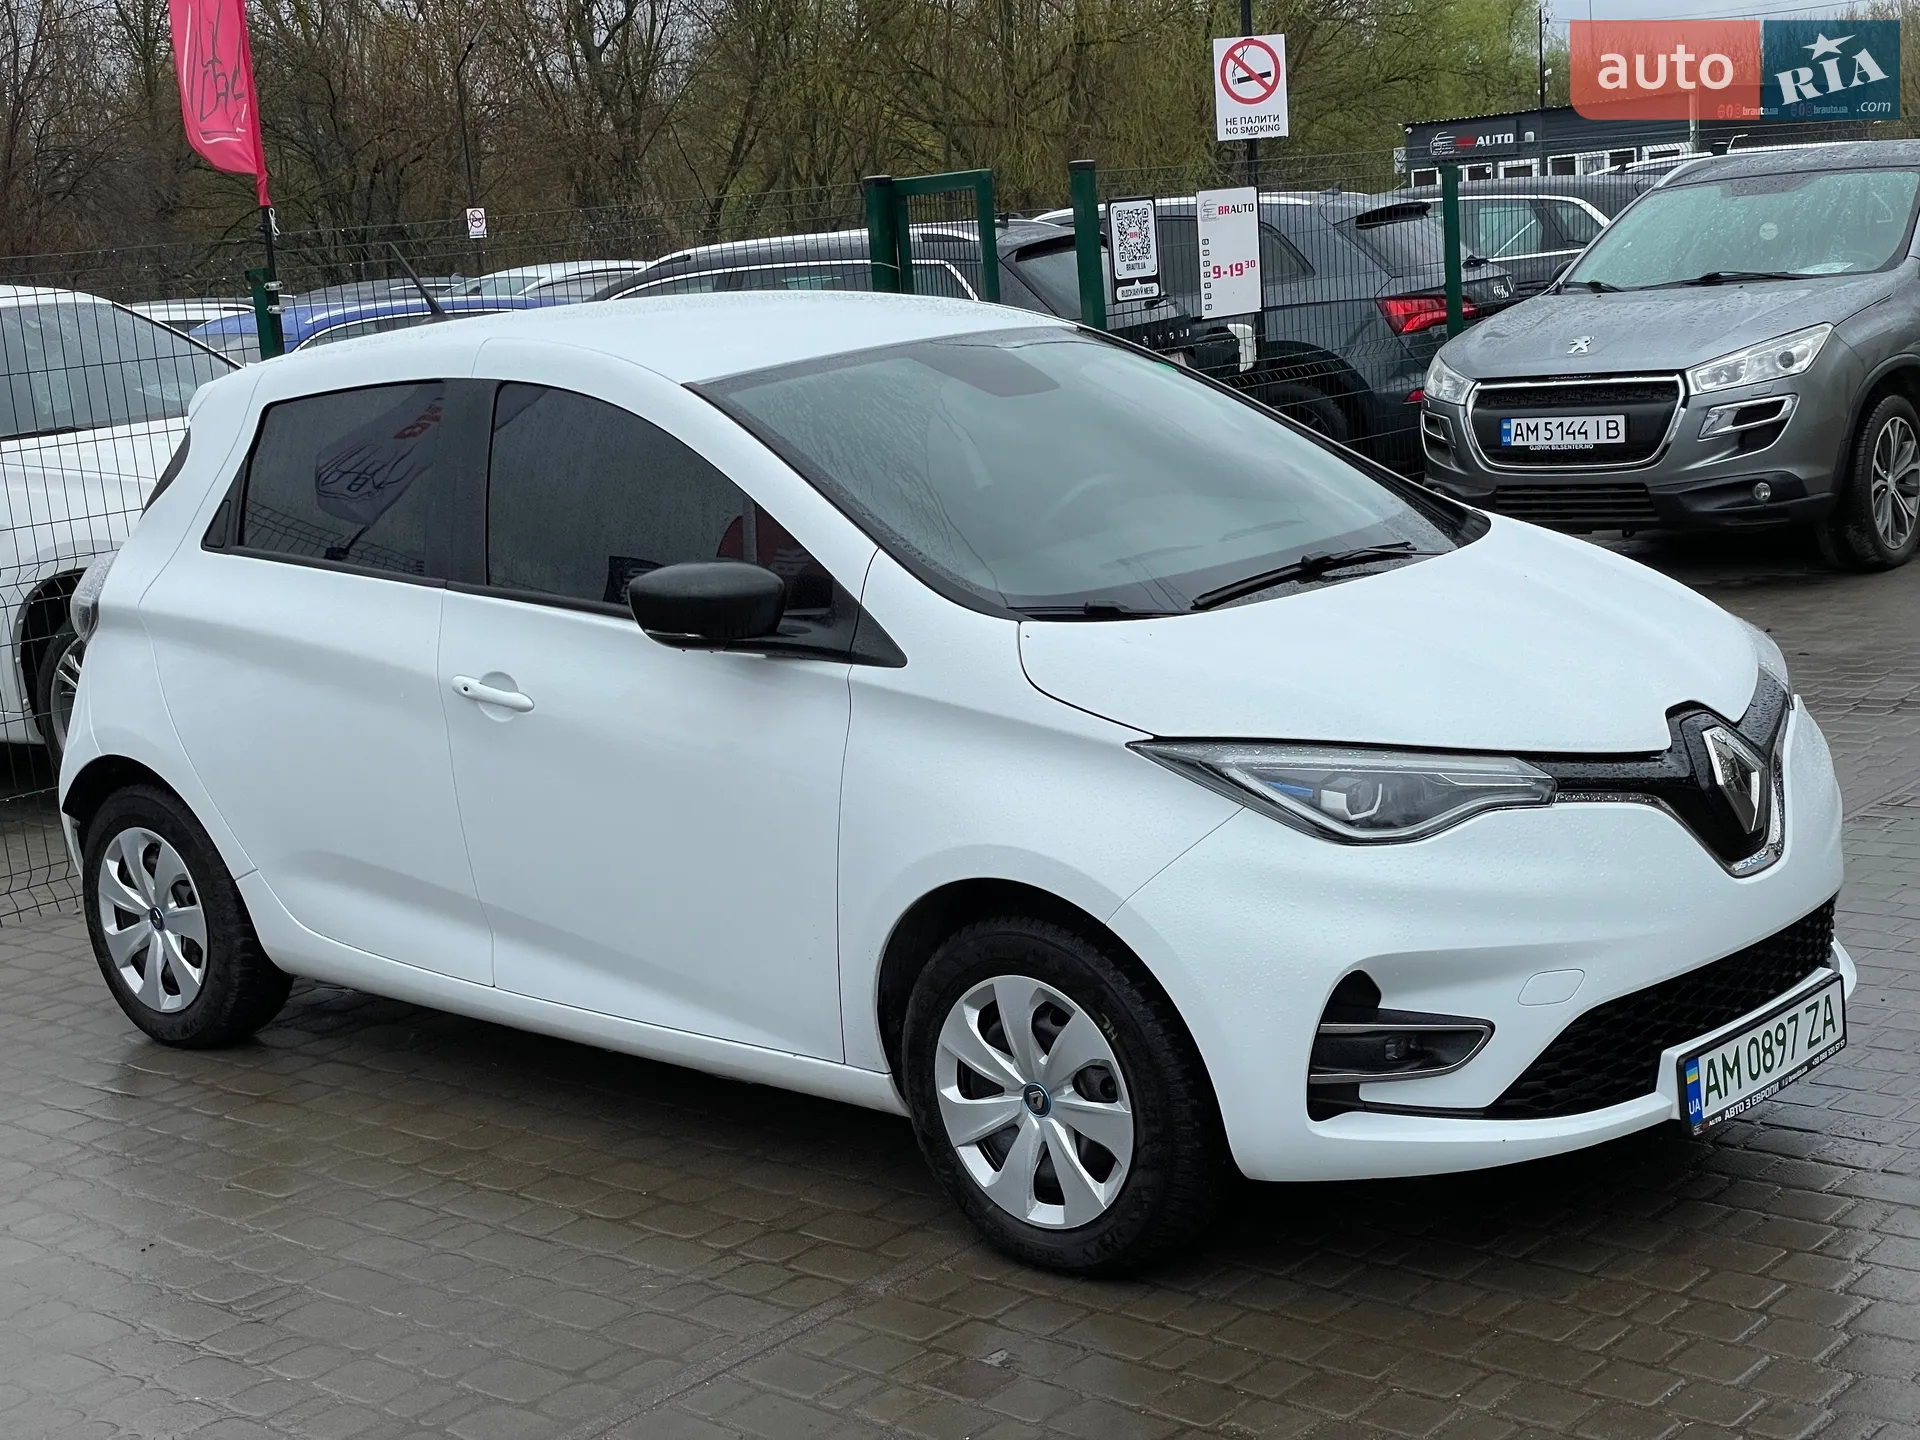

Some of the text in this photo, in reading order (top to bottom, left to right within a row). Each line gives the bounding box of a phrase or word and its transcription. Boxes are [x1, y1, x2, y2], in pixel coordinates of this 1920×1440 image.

[1225, 114, 1280, 126] НЕ ПАЛИТИ
[1225, 124, 1281, 135] NO SMOKING
[1218, 203, 1254, 215] BRAUTO
[1513, 421, 1539, 442] AM
[1544, 420, 1588, 441] 5144
[1688, 993, 1837, 1115] UA AM 0897 ZA
[1724, 1101, 1745, 1120] АВТО
